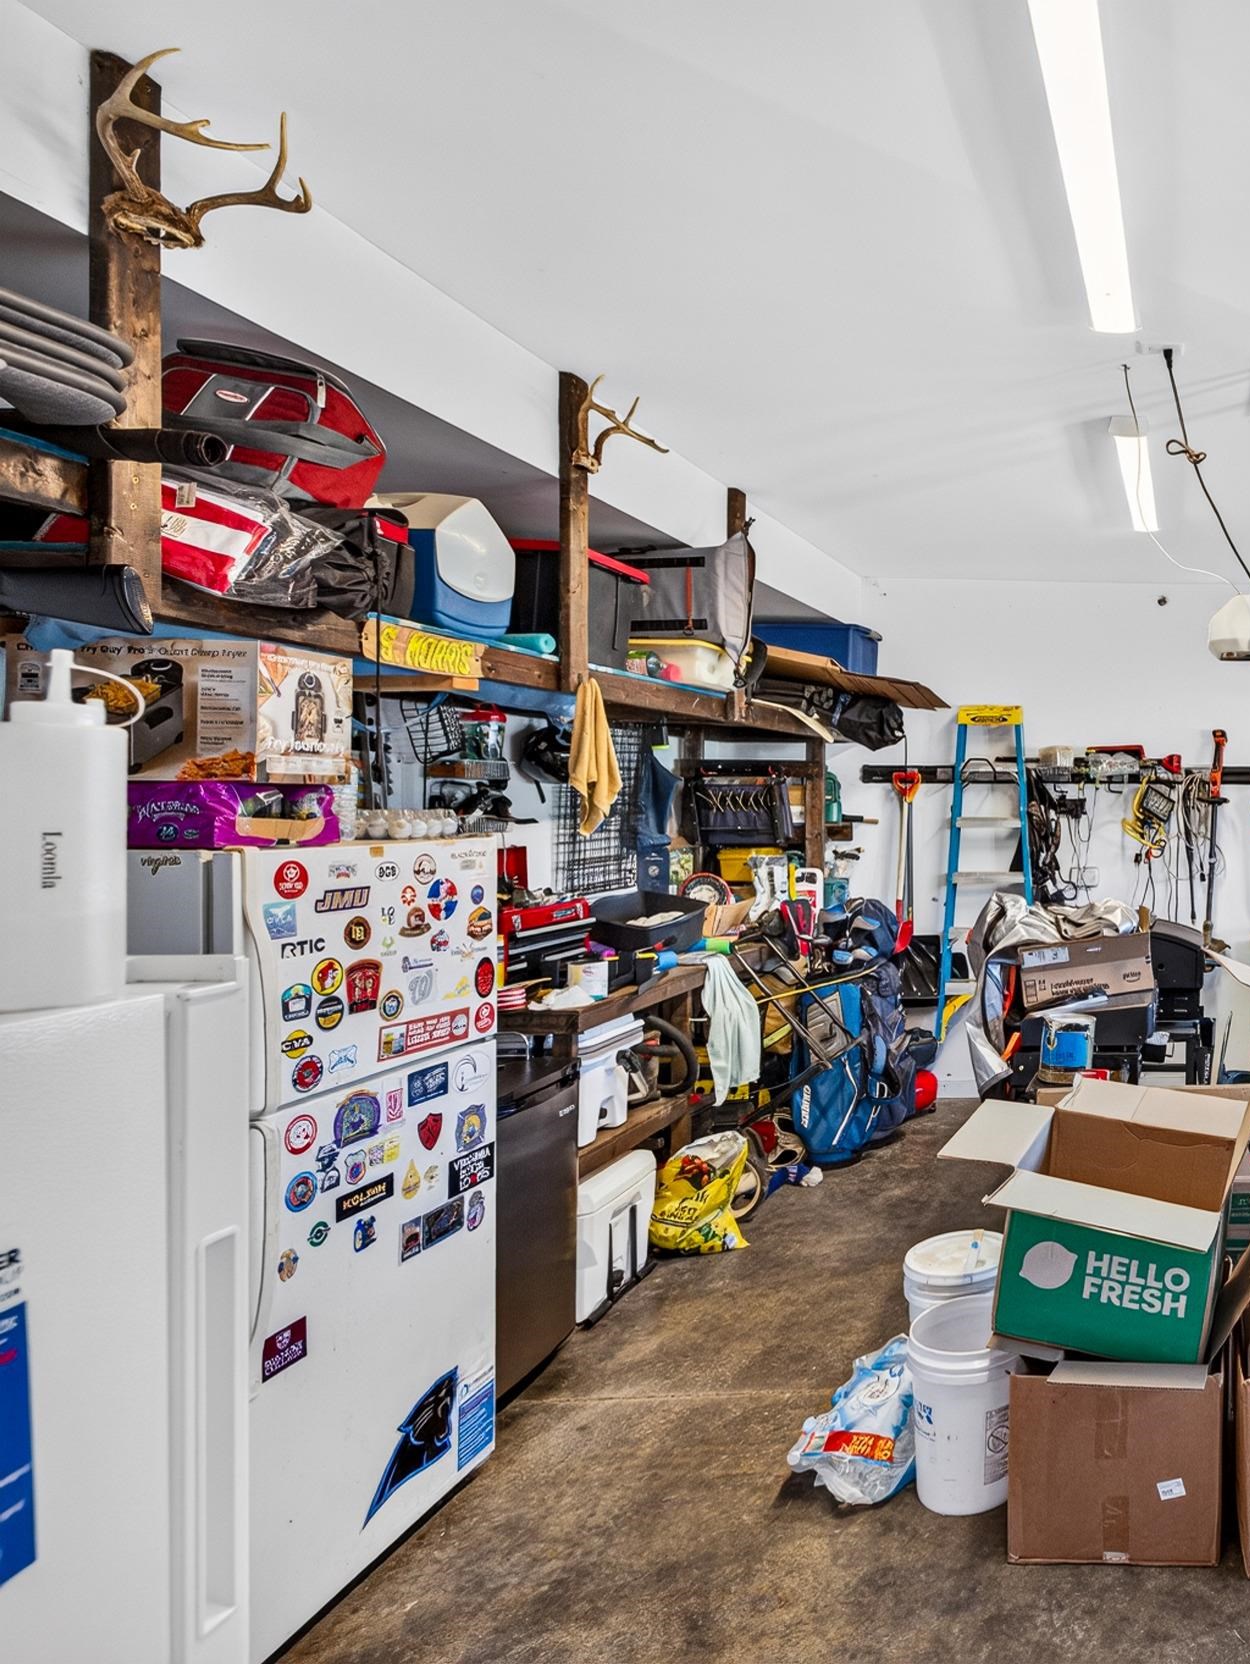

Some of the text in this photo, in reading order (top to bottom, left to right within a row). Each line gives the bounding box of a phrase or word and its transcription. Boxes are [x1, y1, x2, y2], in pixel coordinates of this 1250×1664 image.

[316, 888, 369, 912] JMU
[281, 938, 326, 959] RTIC
[1086, 1250, 1191, 1293] HELLO
[1082, 1275, 1188, 1318] FRESH
